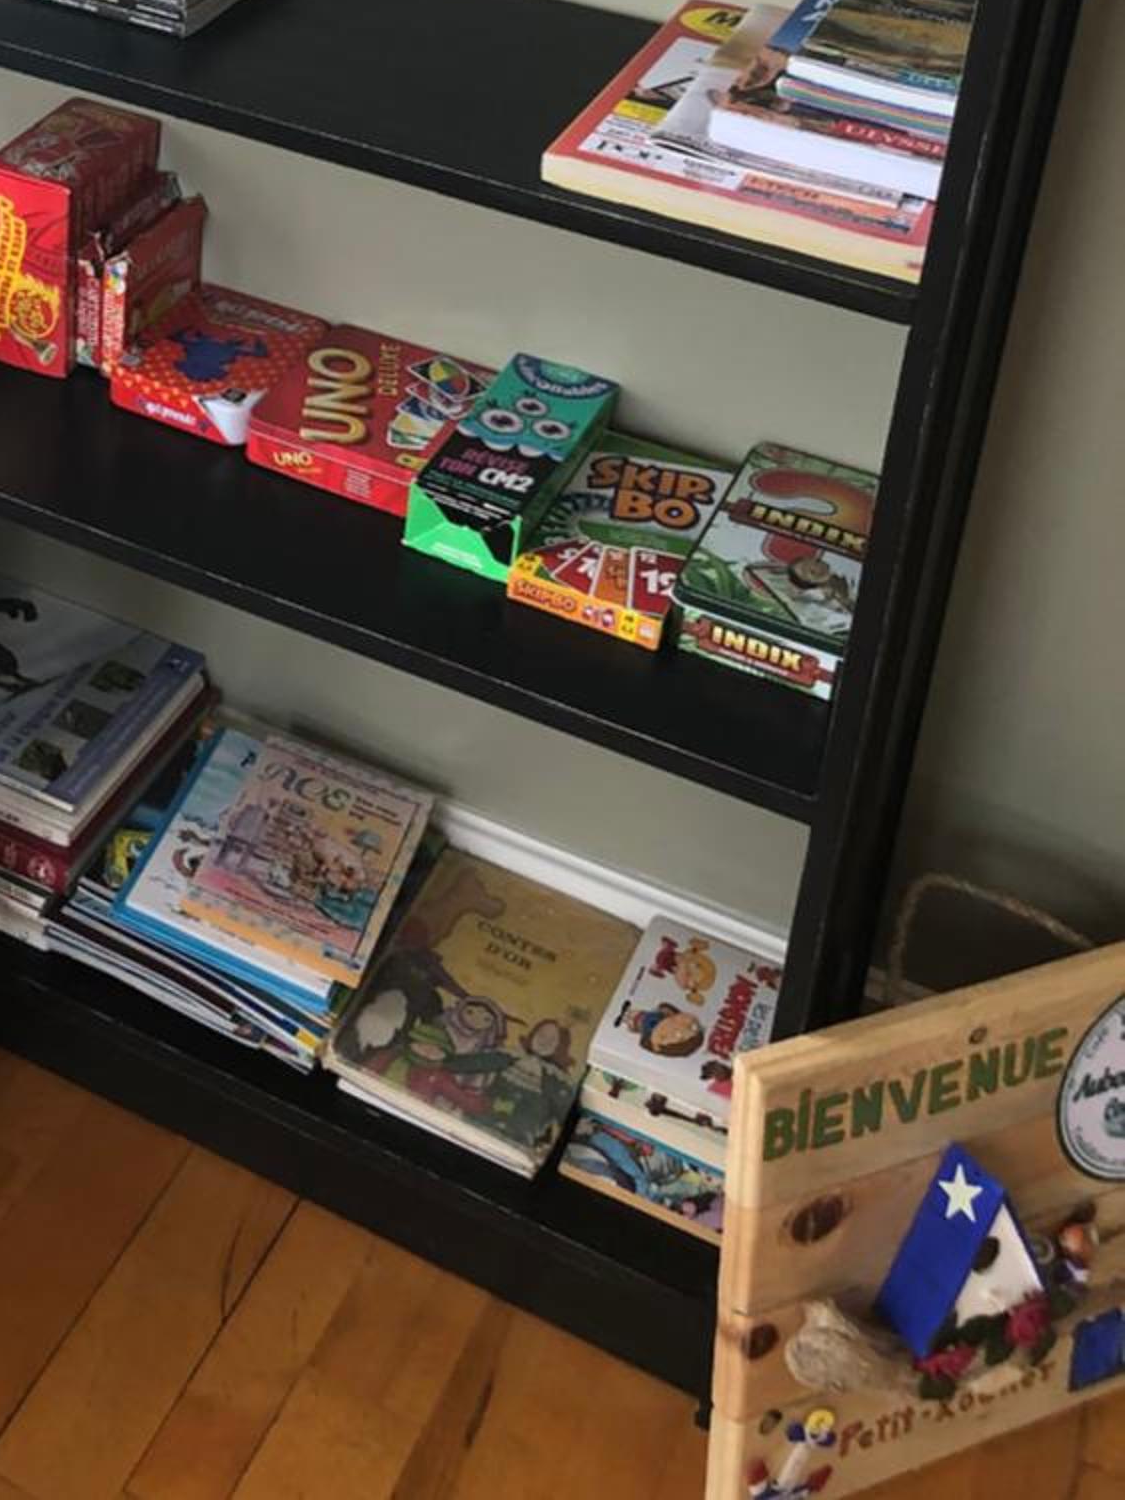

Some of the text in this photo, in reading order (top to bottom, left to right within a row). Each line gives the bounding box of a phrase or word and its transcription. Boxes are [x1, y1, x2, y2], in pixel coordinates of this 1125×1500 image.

[300, 348, 372, 444] UNO
[274, 452, 313, 467] UNO
[478, 467, 534, 494] CM2
[613, 490, 701, 529] BO
[747, 503, 867, 549] INDIX
[712, 625, 802, 672] INDIX
[762, 1026, 1069, 1161] BIENVENUE
